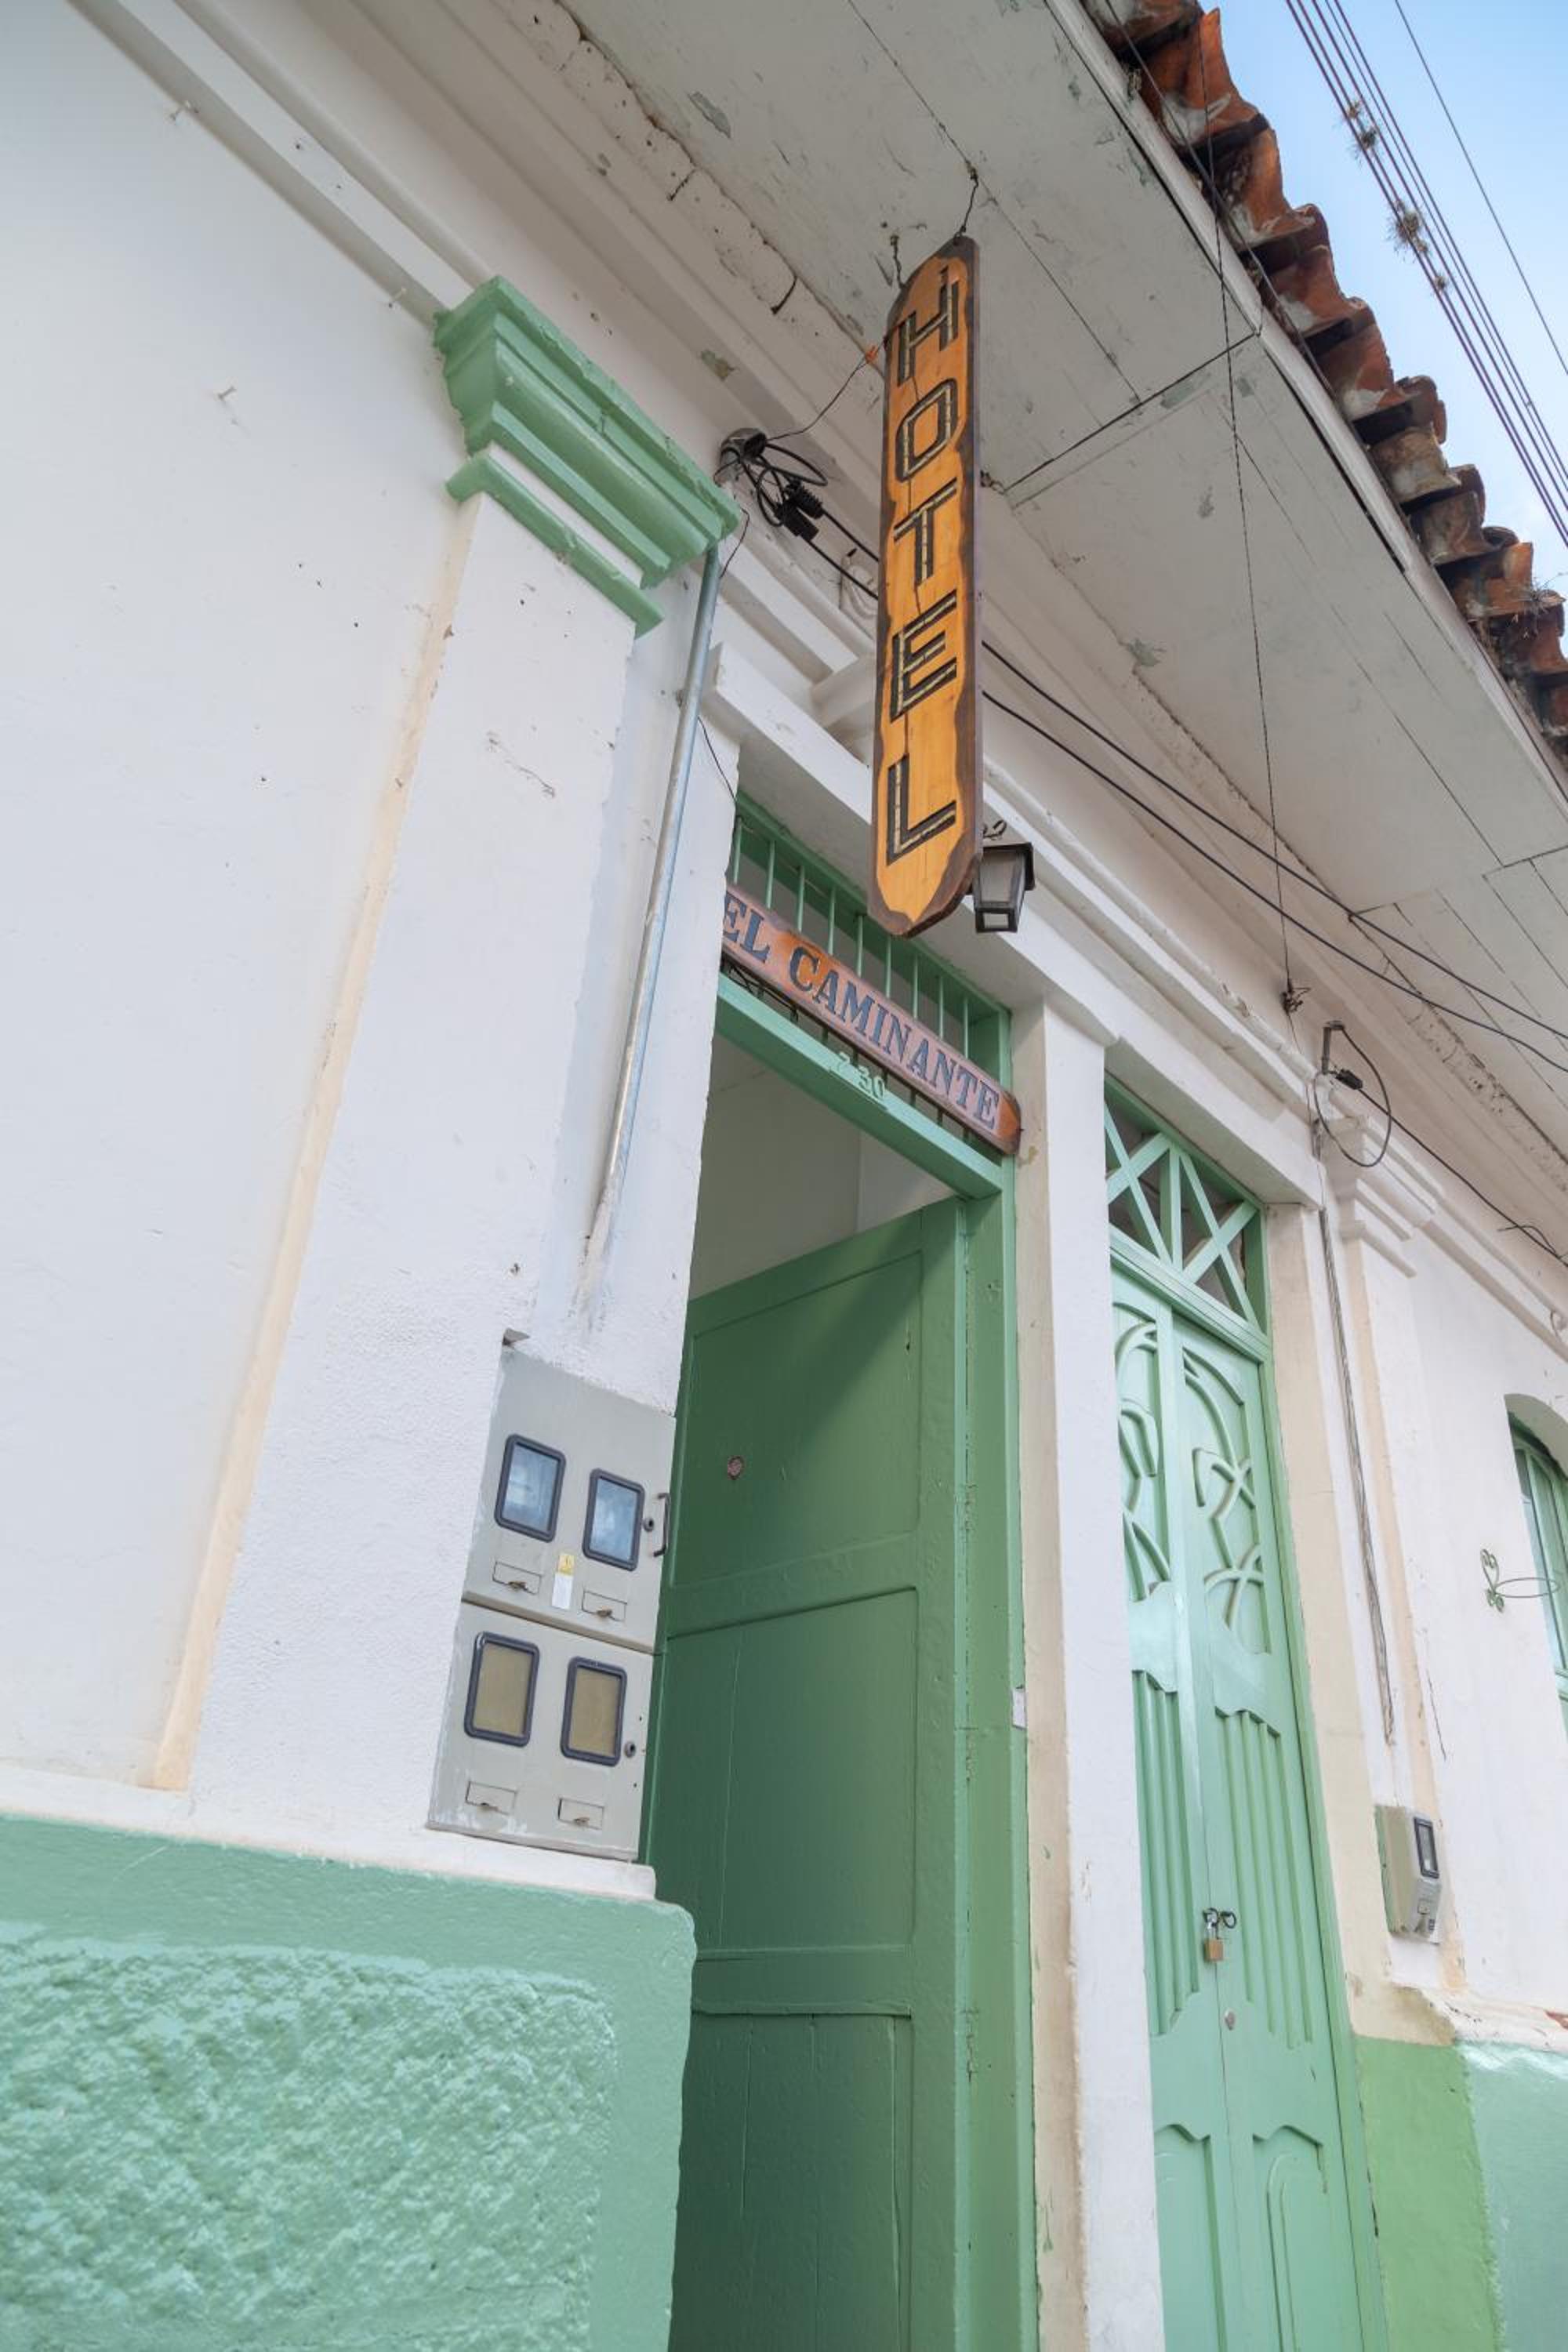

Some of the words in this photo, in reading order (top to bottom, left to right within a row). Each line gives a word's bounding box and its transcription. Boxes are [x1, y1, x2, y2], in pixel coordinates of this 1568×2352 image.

[887, 265, 959, 865] HOTEL
[722, 891, 770, 964] EL
[789, 946, 1000, 1130] CAMINANTE
